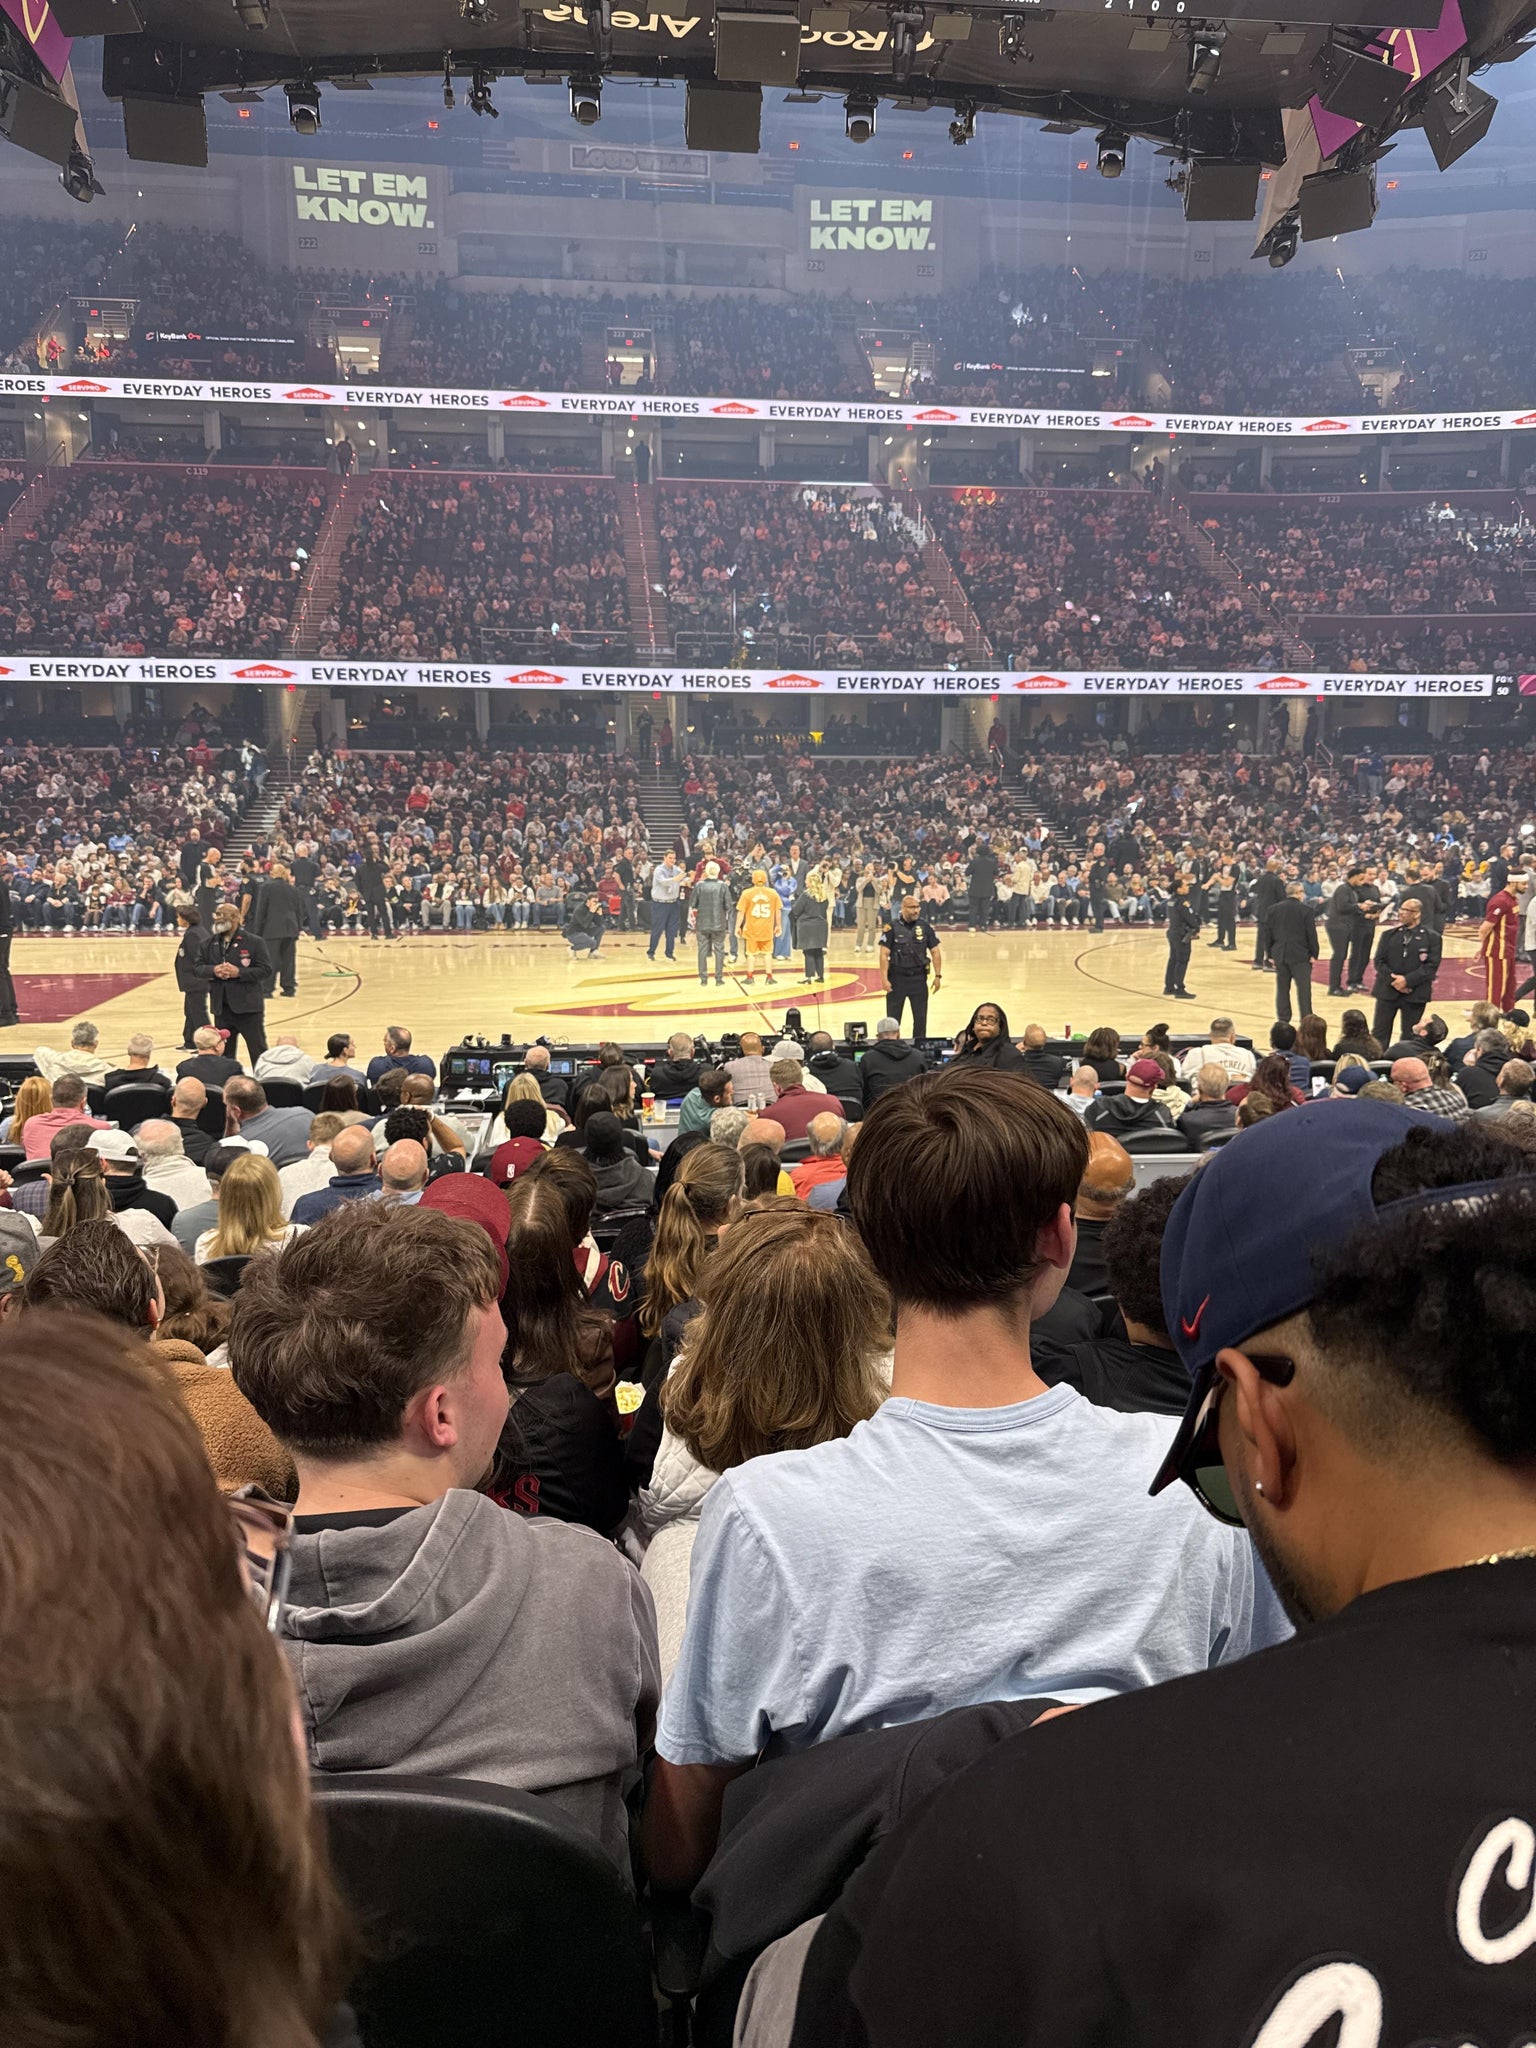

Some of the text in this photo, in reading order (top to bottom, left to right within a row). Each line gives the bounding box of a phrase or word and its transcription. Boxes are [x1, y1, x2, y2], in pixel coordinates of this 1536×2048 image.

[293, 166, 428, 199] LET EM
[296, 195, 435, 229] KNOW.
[810, 199, 932, 222] LET EM
[299, 237, 318, 248] 222
[810, 226, 936, 251] KNOW.
[418, 243, 437, 254] 223
[160, 332, 188, 341] KeyBank
[68, 384, 100, 392] SERVPRO
[123, 383, 203, 399] EVERYDAY
[209, 386, 271, 400] HEROES
[346, 391, 423, 405] EVERYDAY
[429, 394, 489, 407] HEROES
[561, 398, 635, 412] EVERYDAY
[642, 401, 699, 414] HEROES
[769, 405, 841, 419] EVERYDAY
[847, 408, 903, 420] HEROES
[970, 412, 1041, 426] EVERYDAY
[1046, 415, 1100, 427] HEROES
[1165, 419, 1233, 432] EVERYDAY
[1239, 421, 1292, 433] HEROES
[1312, 423, 1341, 431] SERVPRO
[1361, 419, 1437, 431] EVERYDAY
[1442, 416, 1501, 429] HEROES
[194, 467, 208, 476] 119
[1327, 495, 1341, 504] 123
[30, 664, 130, 678] EVERYDAY
[140, 665, 217, 679] HEROES
[312, 667, 408, 682] EVERYDAY
[418, 670, 491, 683] HEROES
[518, 675, 555, 683] SERVPRO
[582, 673, 673, 687] EVERYDAY
[682, 675, 751, 688] HEROES
[837, 677, 925, 690] EVERYDAY
[933, 678, 1000, 690] HEROES
[1025, 680, 1059, 688] SERVPRO
[1083, 677, 1170, 690] EVERYDAY
[1178, 679, 1243, 691] HEROES
[1324, 680, 1406, 692] EVERYDAY
[1415, 680, 1484, 693] HEROES
[1496, 686, 1509, 696] 50
[751, 903, 771, 919] 45
